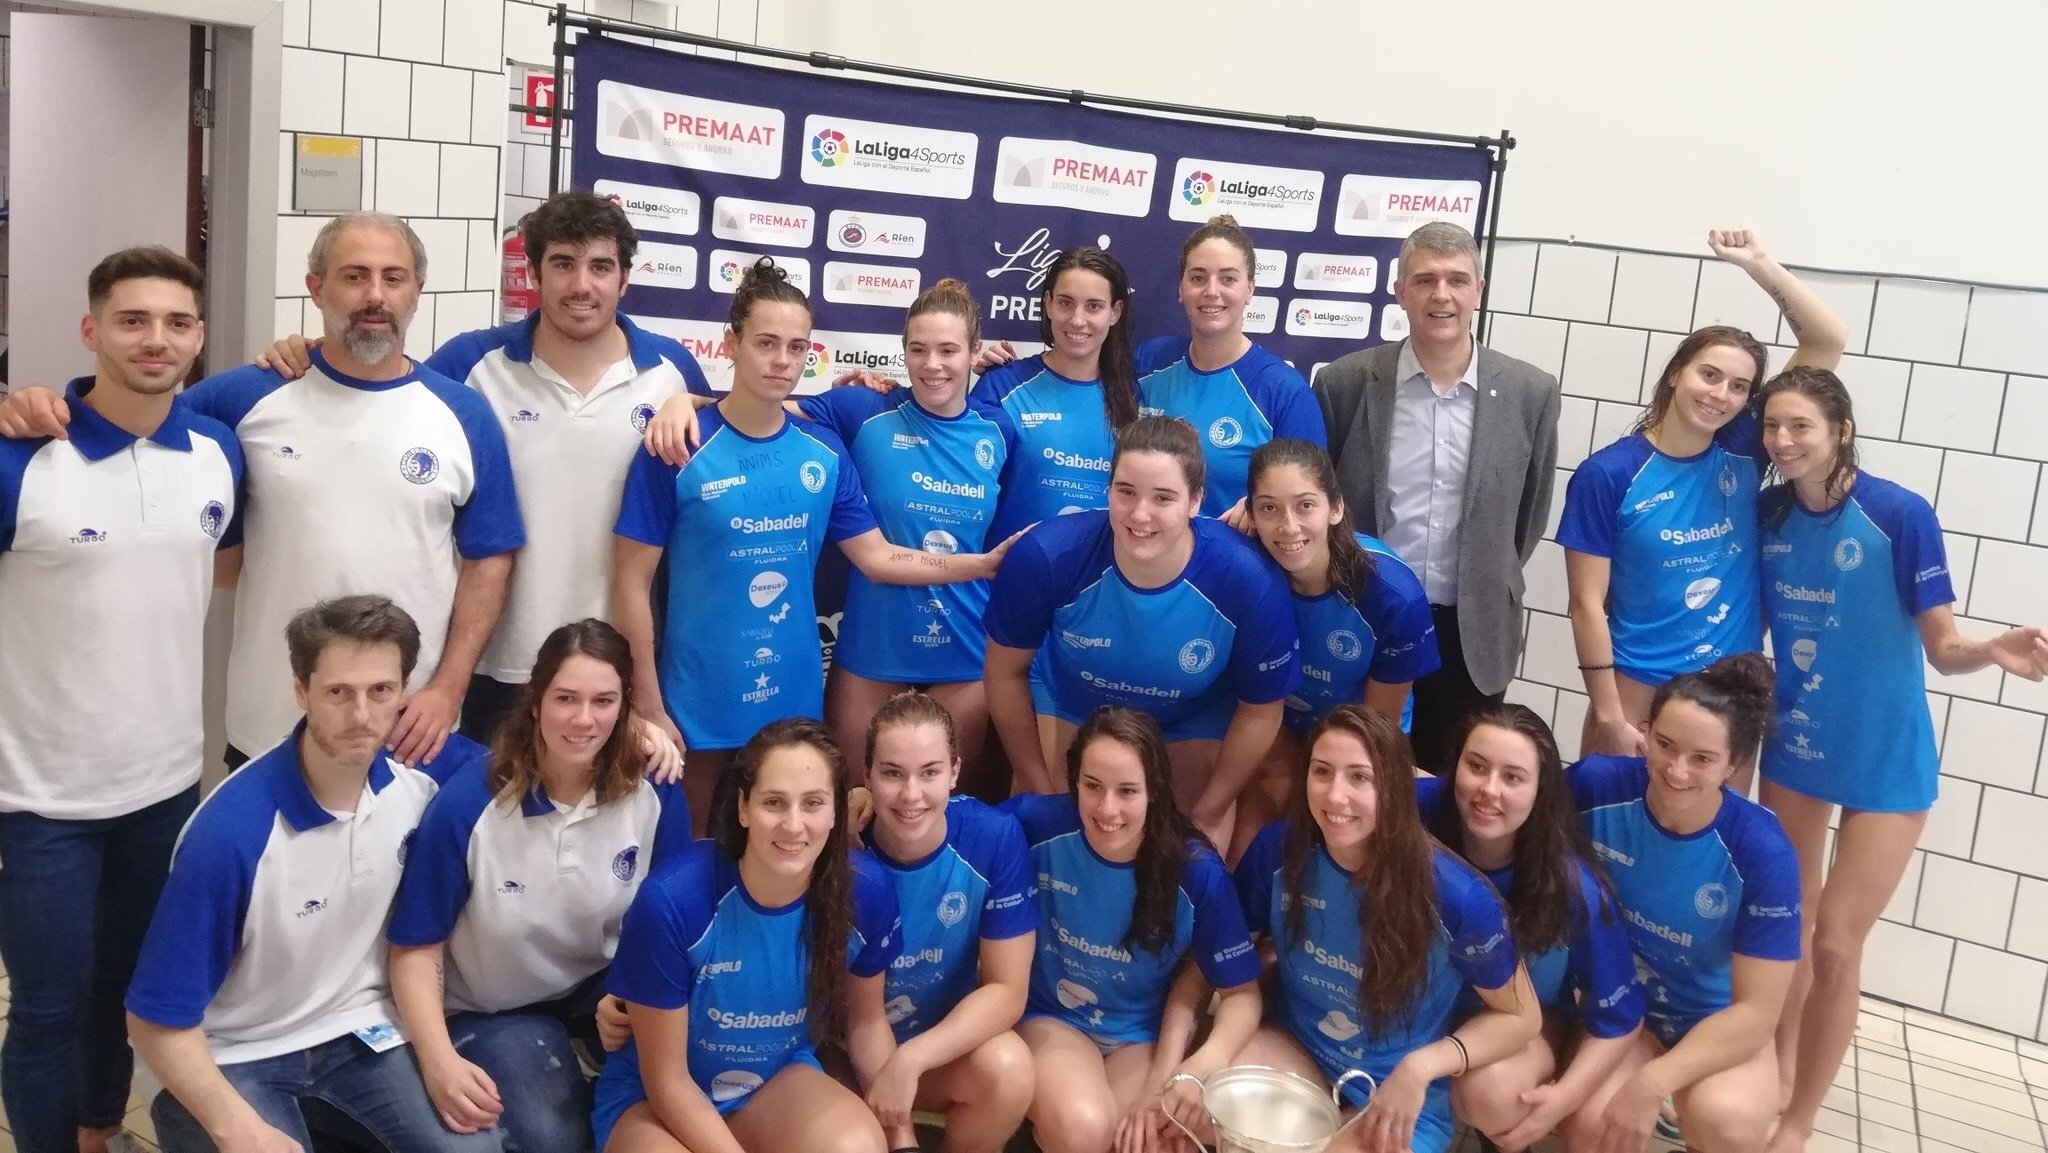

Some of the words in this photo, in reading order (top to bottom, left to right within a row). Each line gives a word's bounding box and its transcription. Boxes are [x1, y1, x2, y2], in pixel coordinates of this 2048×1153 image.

[664, 111, 775, 146] PREMAAT
[704, 143, 732, 156] AHORRO
[855, 140, 965, 166] LaLiga4Sports
[1053, 158, 1148, 187] PREMAAT
[1220, 180, 1315, 201] LaLiga4Sports
[626, 199, 688, 216] LaLiga4Sports
[1388, 194, 1473, 213] PREMAAT
[750, 213, 808, 229] PREMAAT
[1324, 265, 1371, 277] PREMAAT
[857, 275, 914, 290] PREMAAT
[512, 413, 540, 422] TURBO
[1021, 412, 1062, 421] WATERPOLO
[701, 475, 746, 493] WATERPOLO
[922, 476, 985, 499] Sabadell
[743, 513, 809, 534] Sabadell
[69, 535, 106, 544] TURBO
[912, 634, 951, 643] ESTRELLA
[742, 686, 780, 702] ESTRELLA
[1093, 678, 1180, 698] Sabadell
[296, 899, 328, 919] TURBO
[1058, 927, 1132, 964] Sabadell
[719, 1007, 807, 1029] Sabadell
